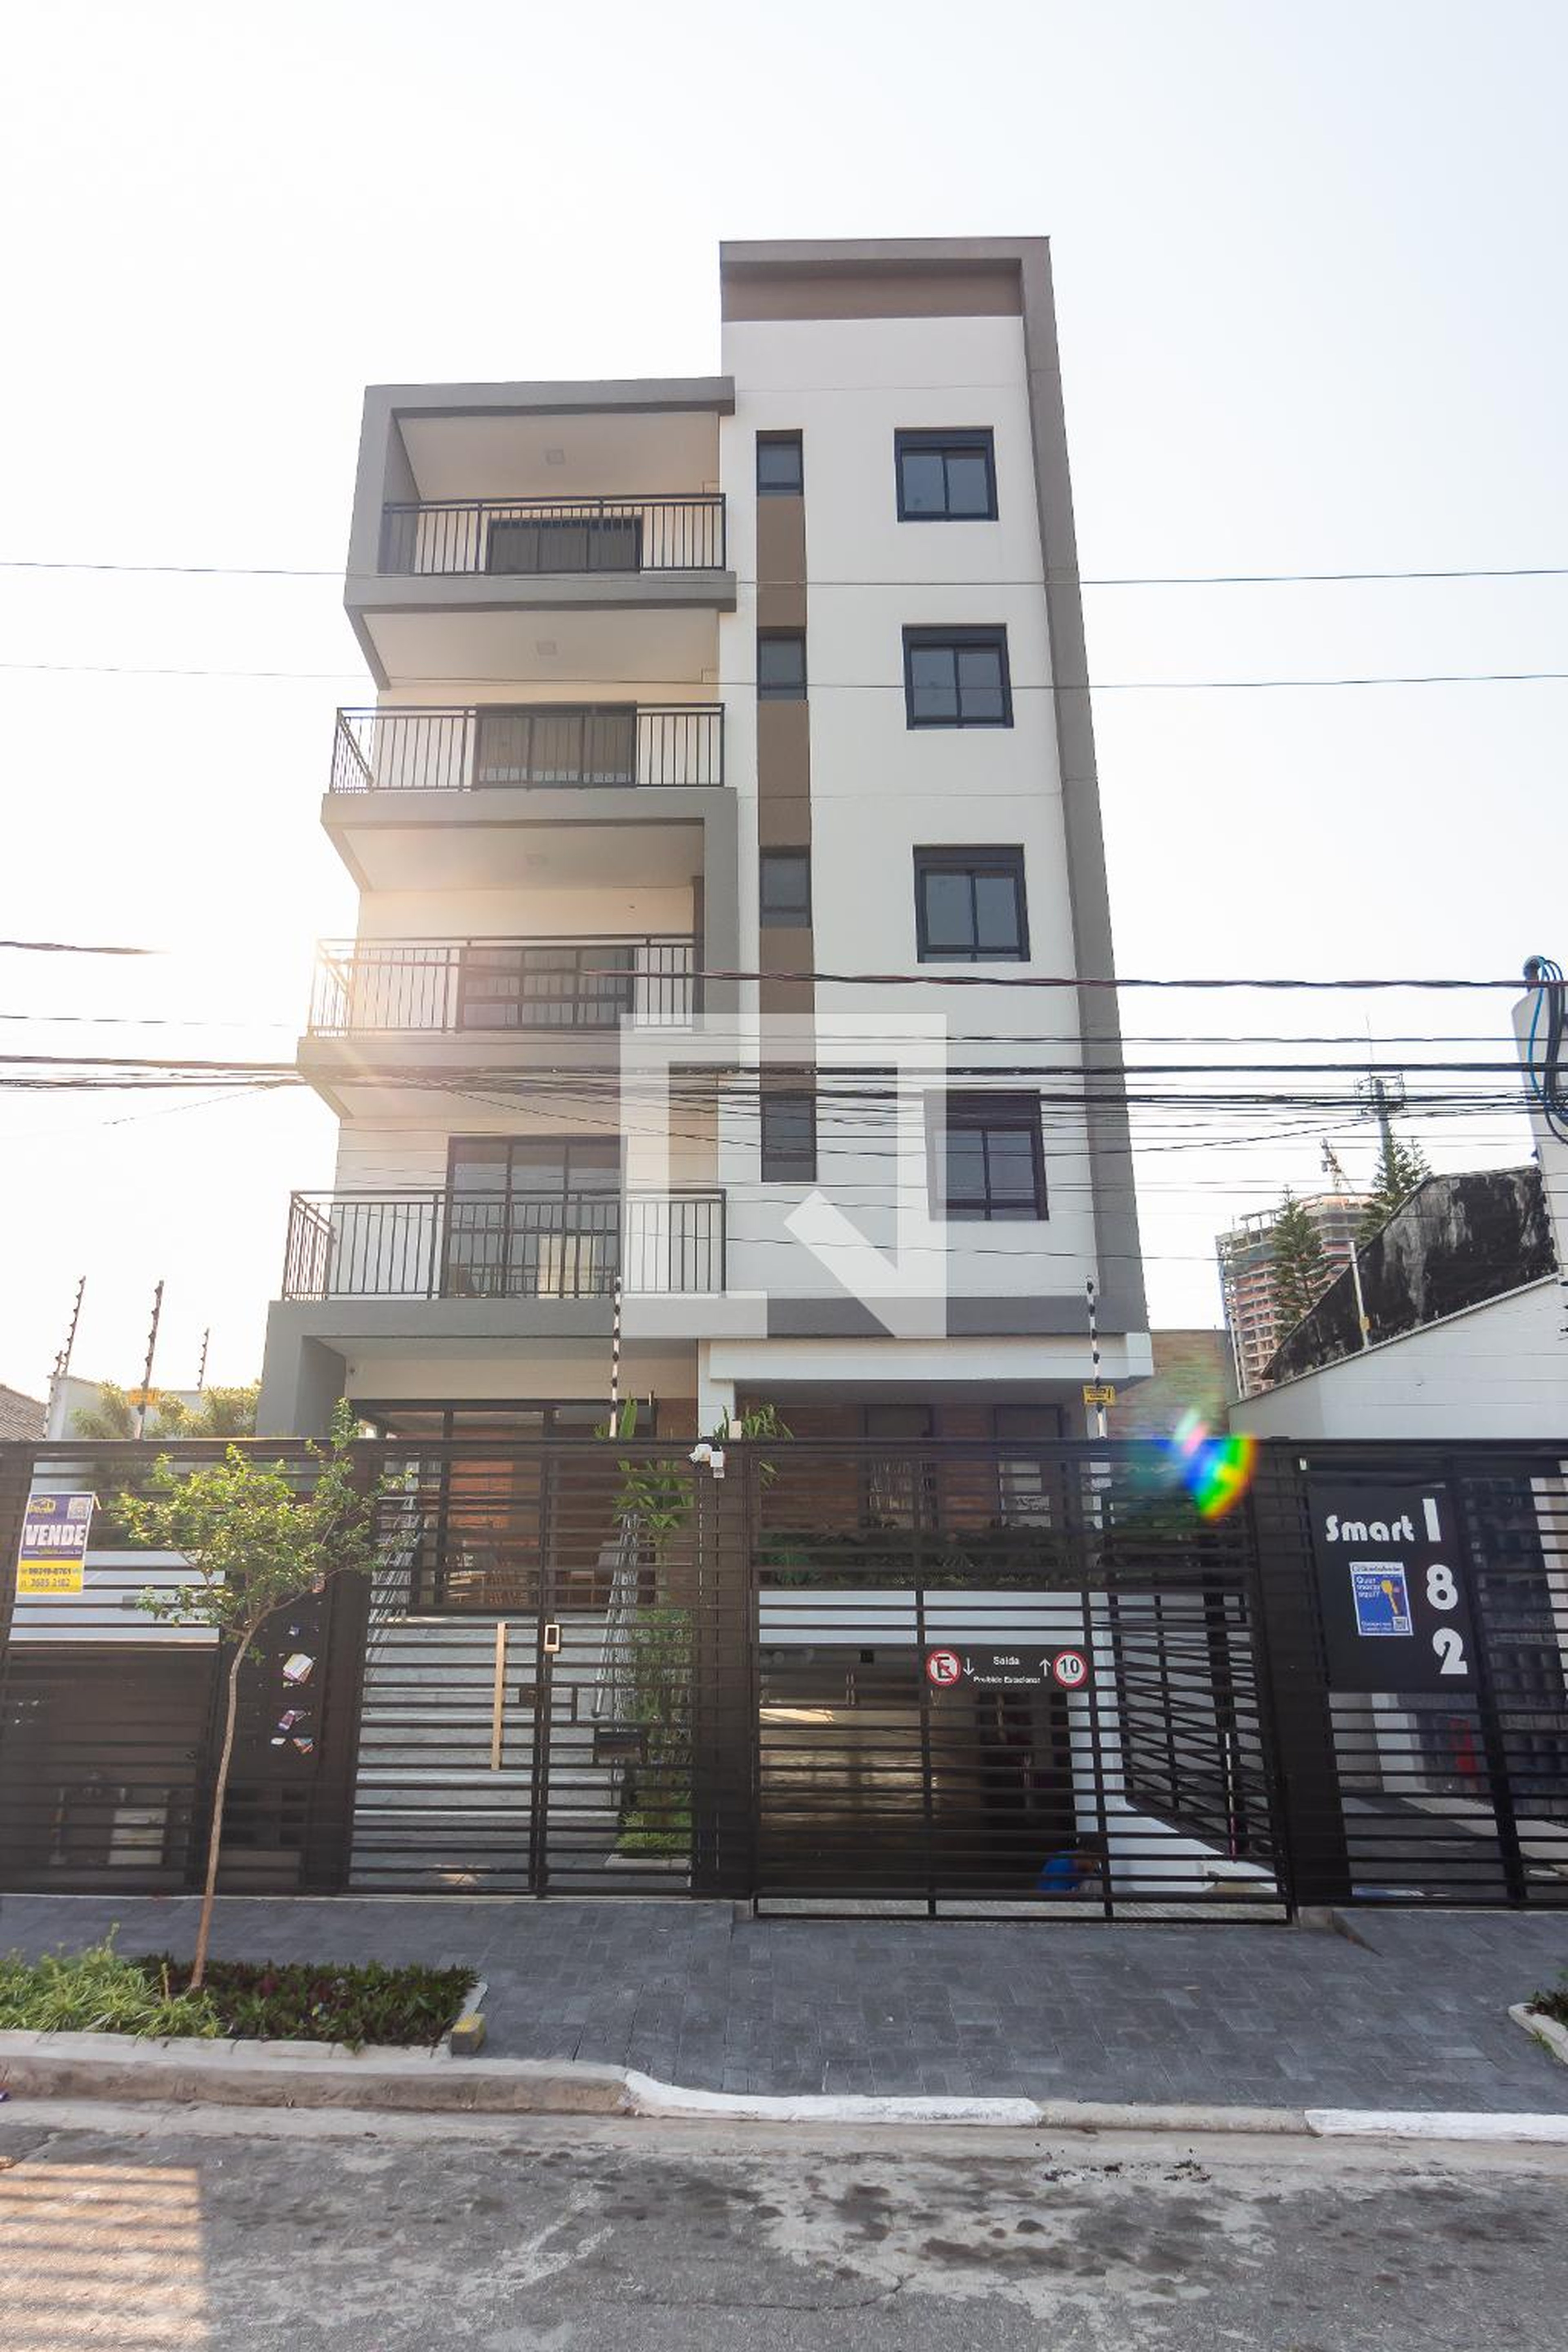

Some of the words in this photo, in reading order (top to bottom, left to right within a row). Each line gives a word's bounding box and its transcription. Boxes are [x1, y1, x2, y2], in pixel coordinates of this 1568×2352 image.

[25, 1524, 87, 1546] VENDE
[1326, 1515, 1415, 1541] Smart
[1060, 1658, 1080, 1674] 10
